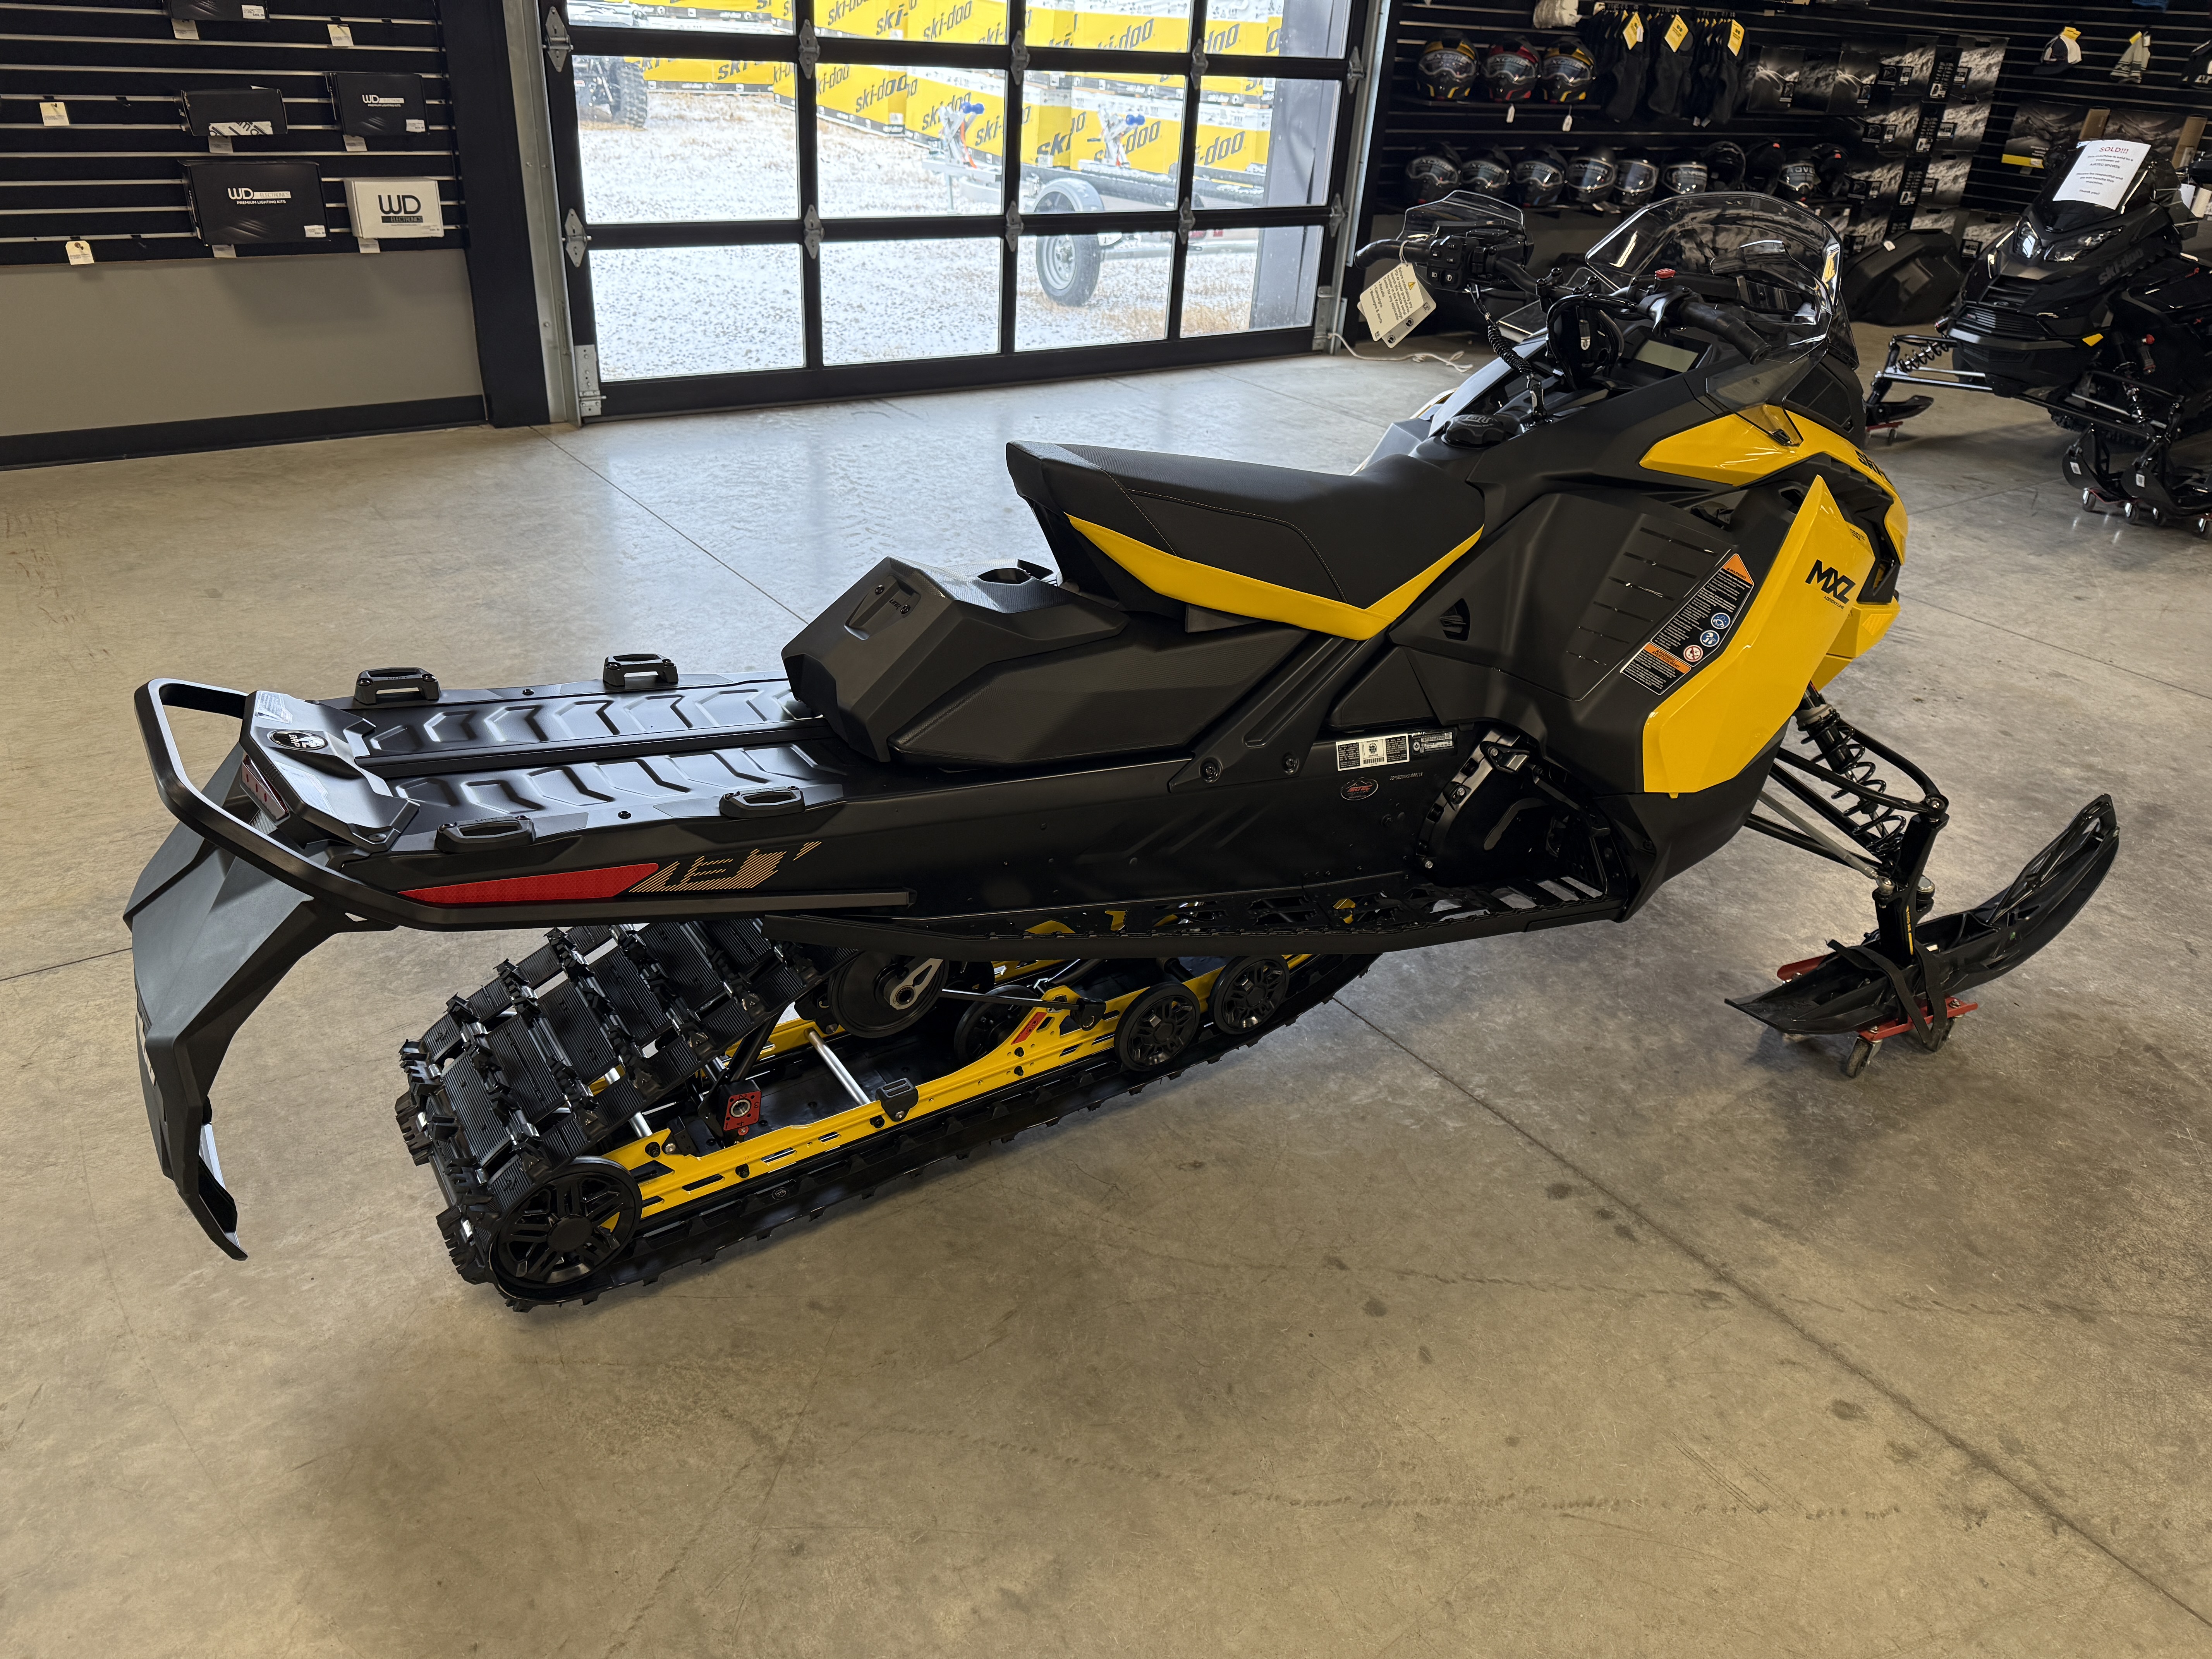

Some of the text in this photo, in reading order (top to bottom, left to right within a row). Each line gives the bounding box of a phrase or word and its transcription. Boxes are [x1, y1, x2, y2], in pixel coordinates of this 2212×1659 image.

[856, 74, 907, 112] ski-doo
[228, 188, 254, 200] WD
[378, 195, 421, 215] WD
[1805, 559, 1856, 604] MXZ
[289, 734, 301, 747] BRP
